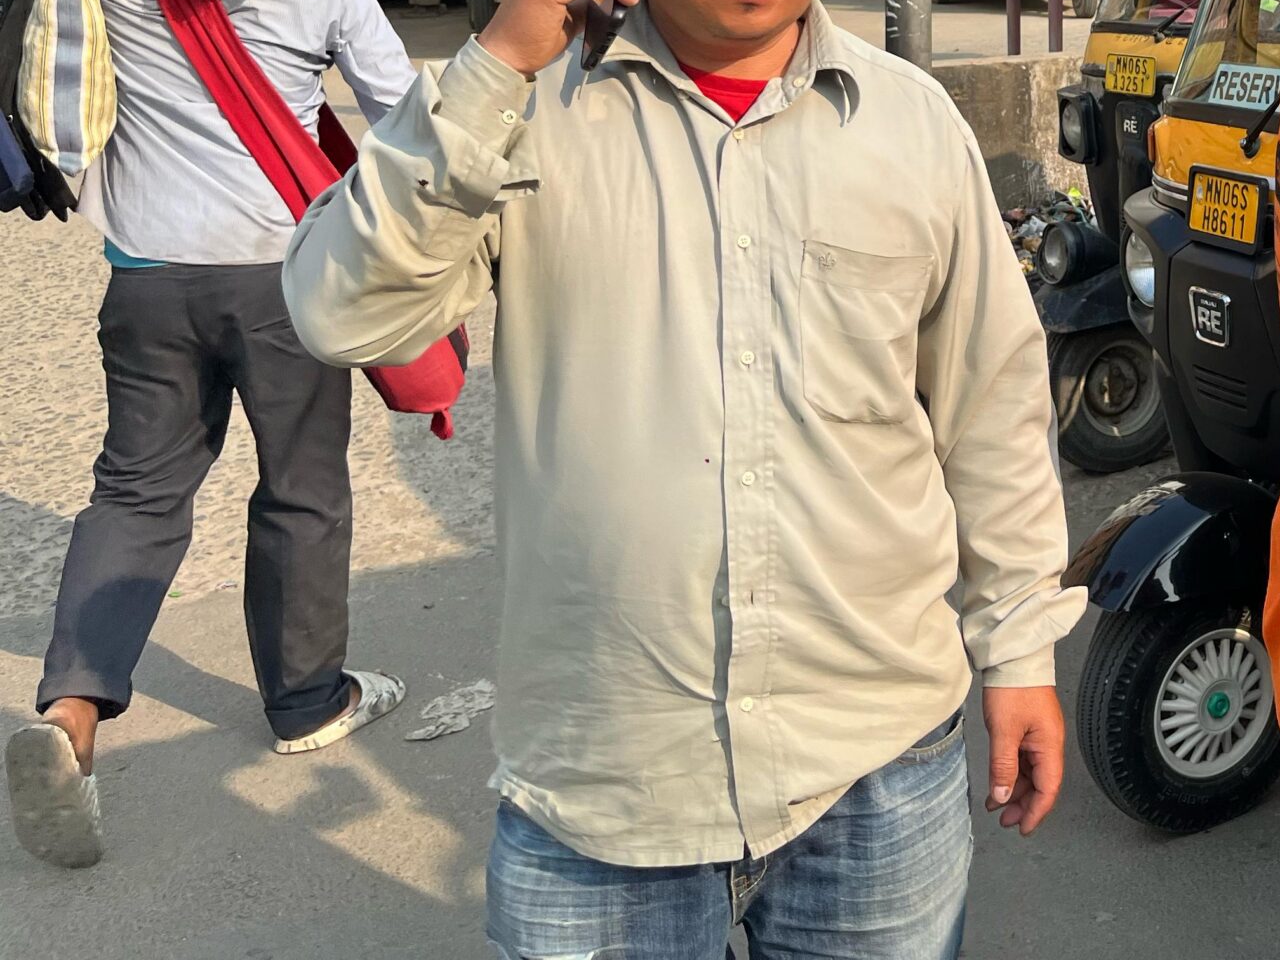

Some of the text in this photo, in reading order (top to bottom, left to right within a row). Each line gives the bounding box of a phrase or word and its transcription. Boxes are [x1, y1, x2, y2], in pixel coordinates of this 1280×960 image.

[1116, 57, 1147, 75] MN06S
[1113, 74, 1145, 93] A3251
[1123, 119, 1138, 134] RE
[1205, 177, 1249, 210] MN06S
[1202, 205, 1245, 240] H8611
[1197, 305, 1223, 335] RE
